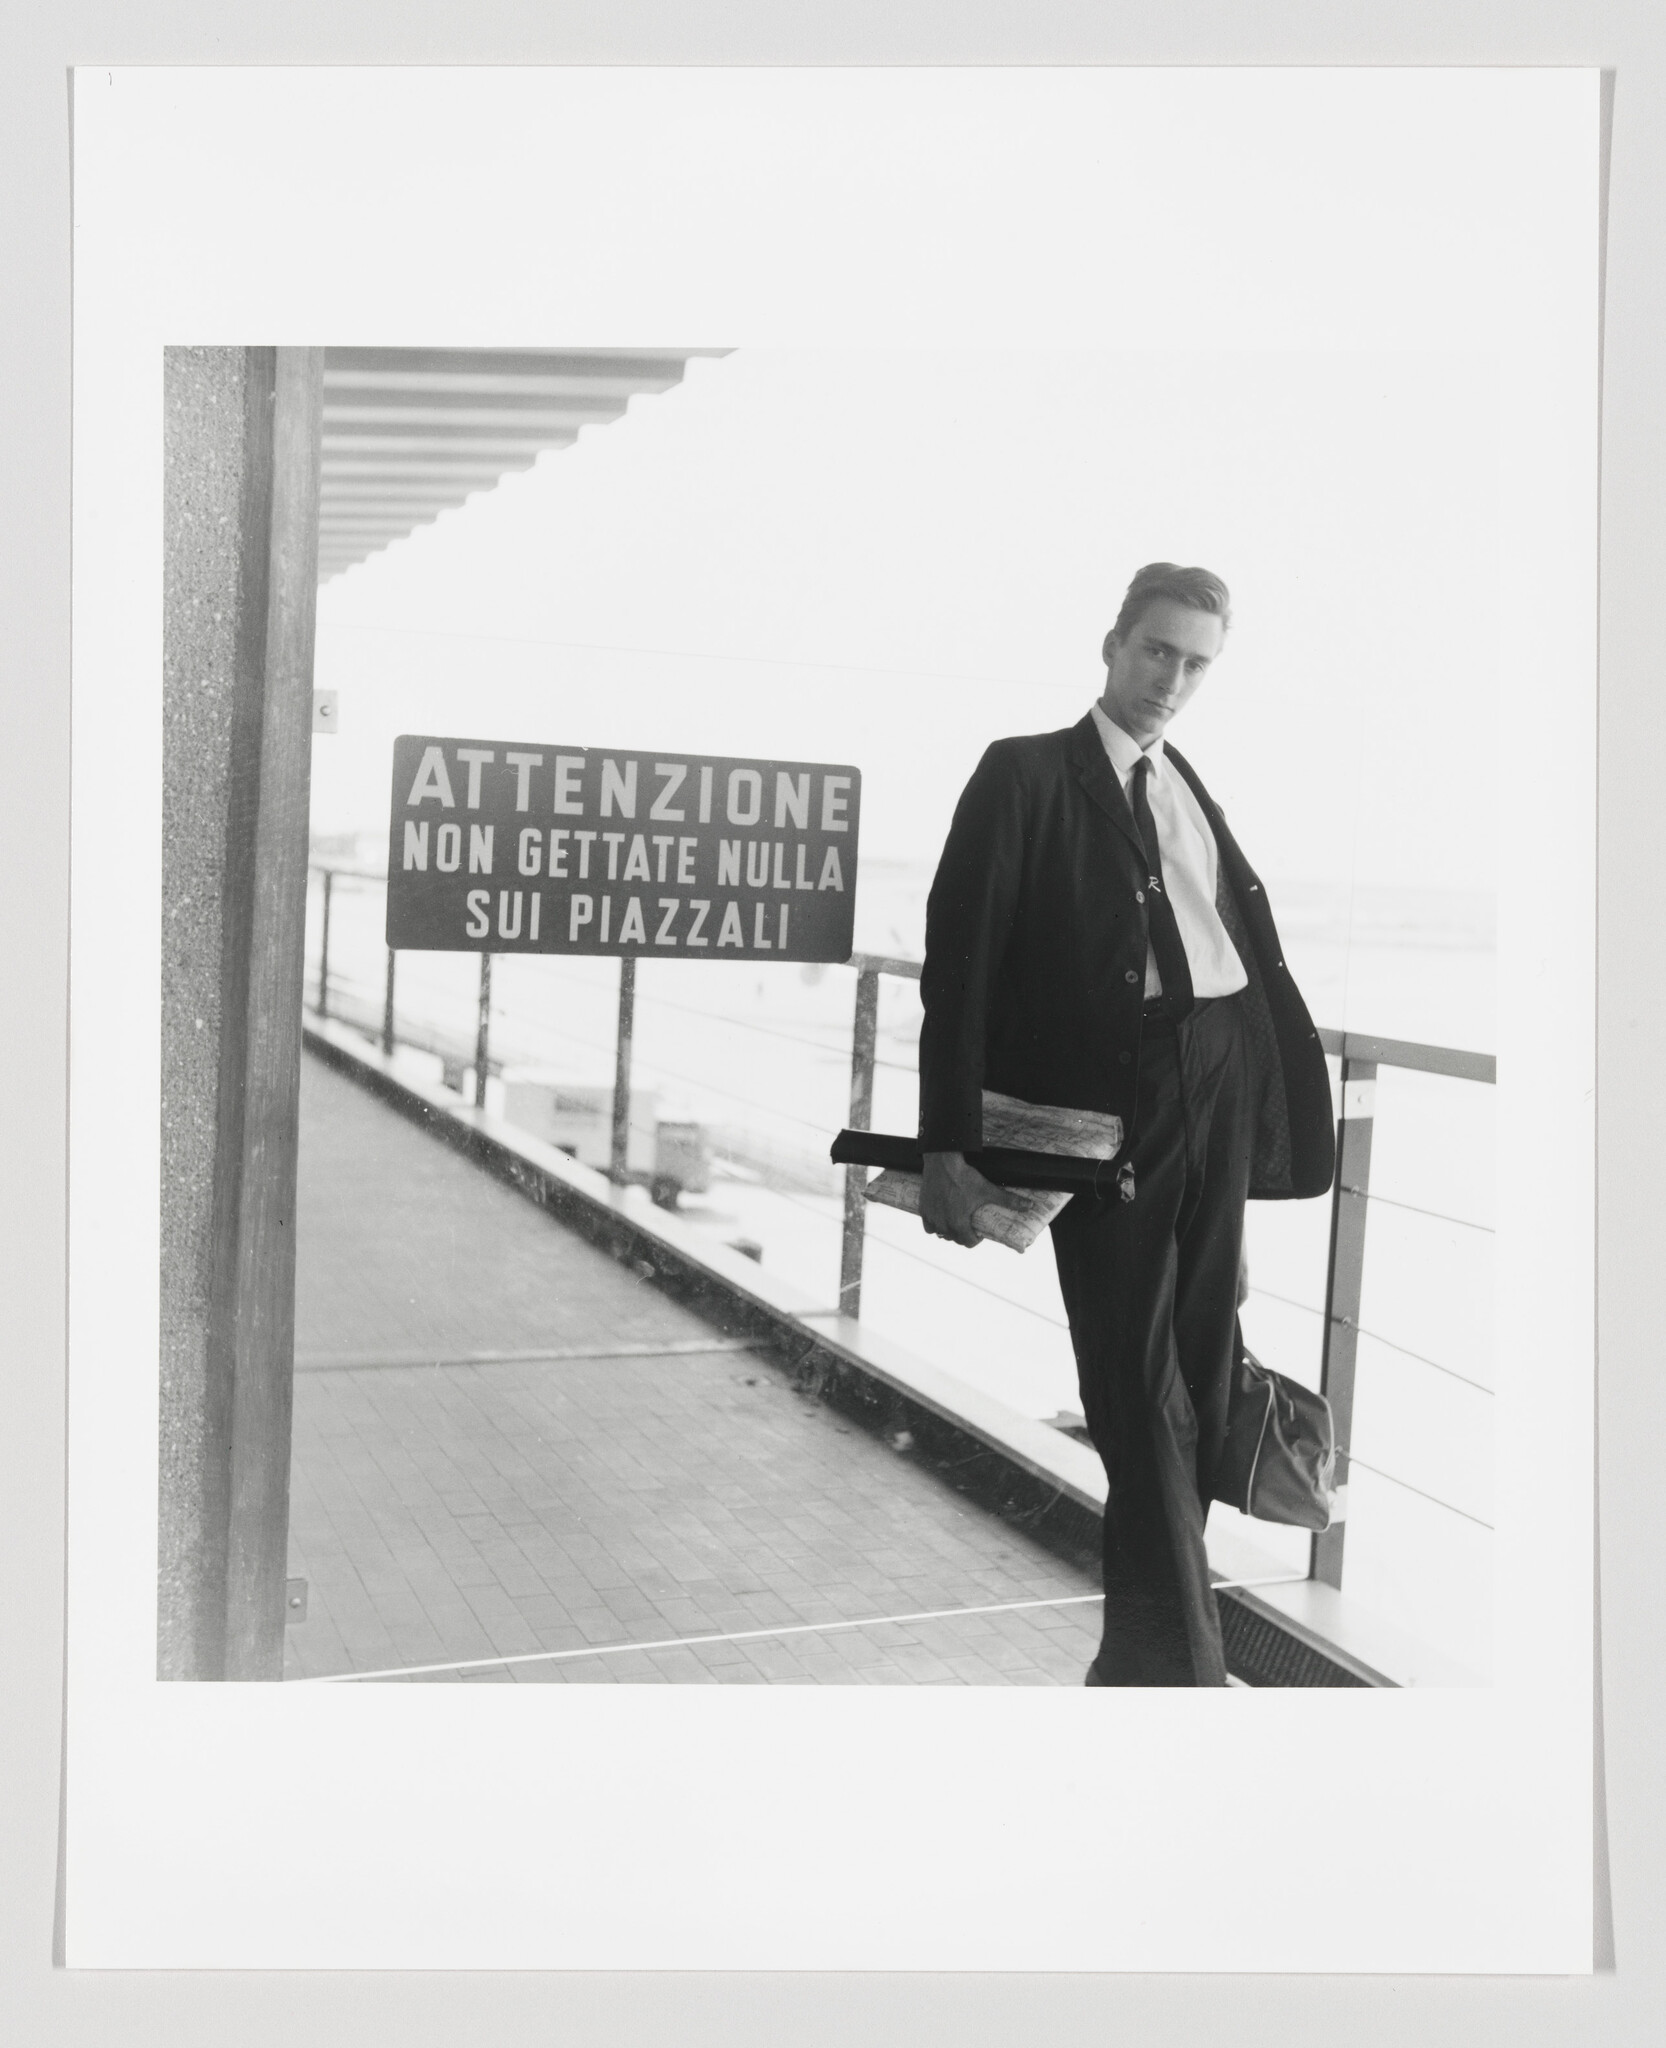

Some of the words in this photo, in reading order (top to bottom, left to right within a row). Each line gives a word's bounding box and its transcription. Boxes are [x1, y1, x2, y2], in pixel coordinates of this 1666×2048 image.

[406, 746, 851, 832] ATTENZIONE
[402, 820, 495, 875] NON
[517, 827, 698, 885] GETTATE
[717, 839, 845, 892] NULLA
[465, 888, 542, 941] SUI
[568, 893, 790, 950] PIAZZALI
